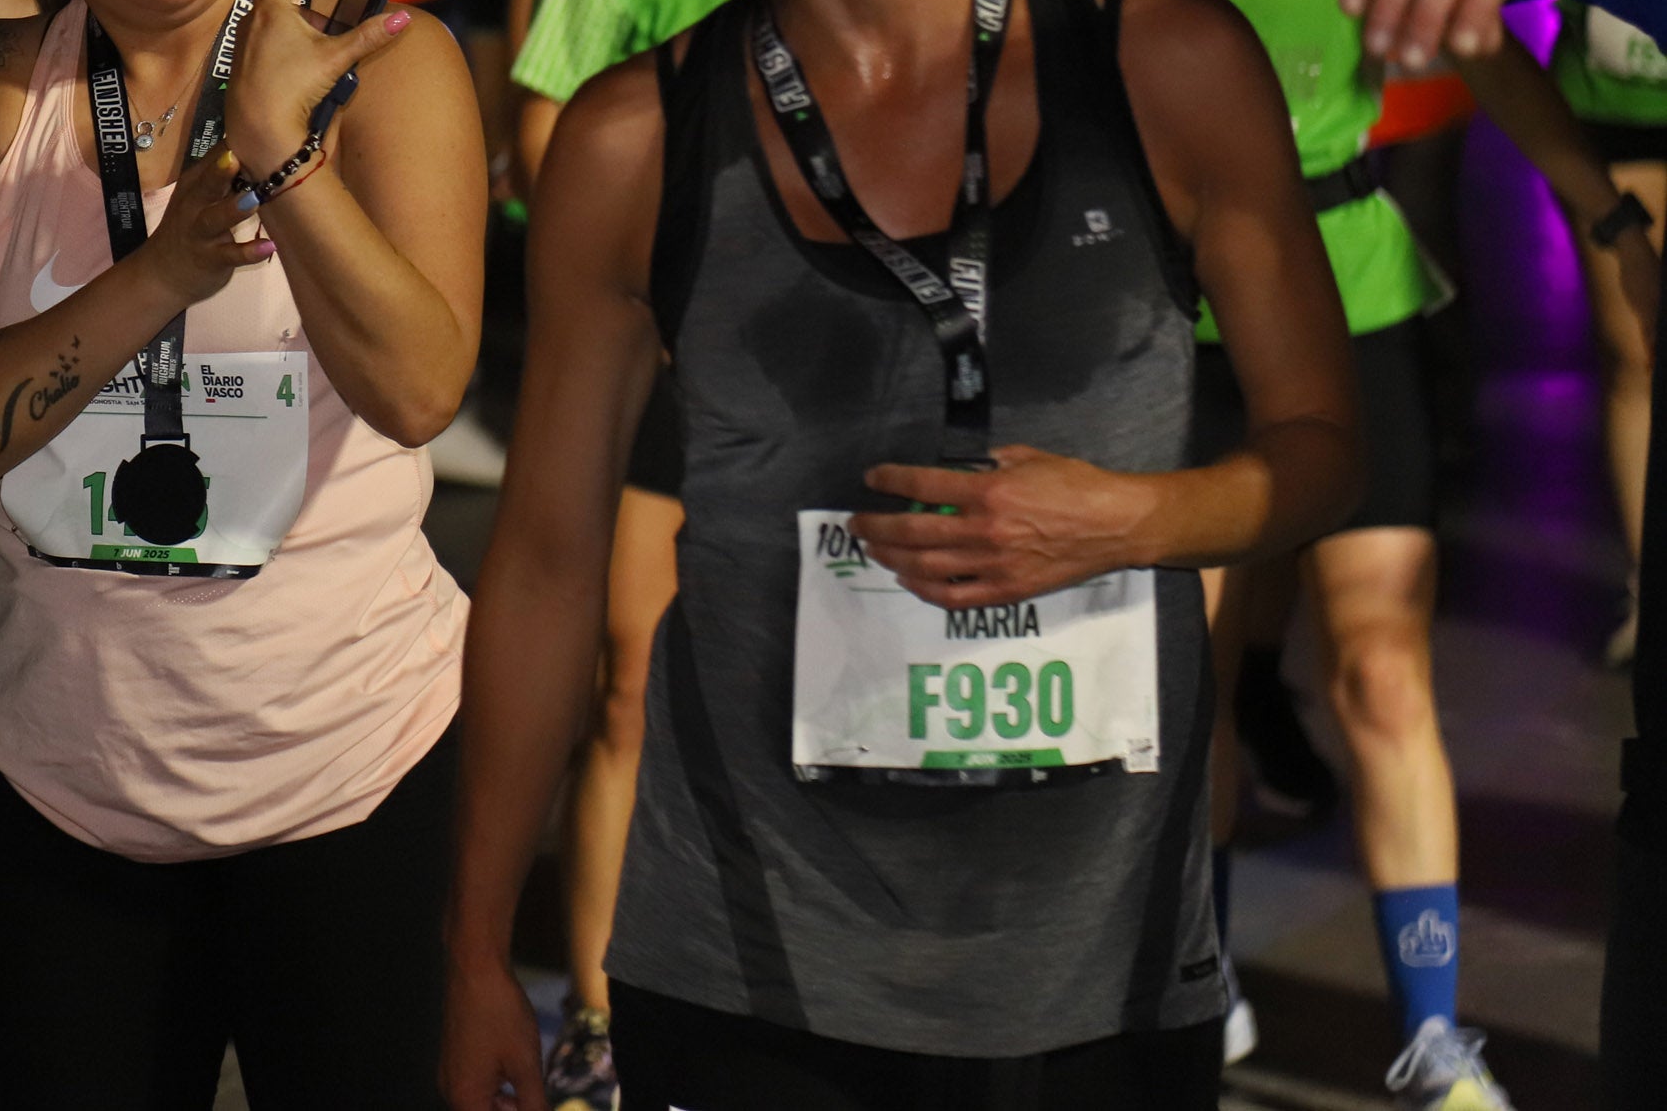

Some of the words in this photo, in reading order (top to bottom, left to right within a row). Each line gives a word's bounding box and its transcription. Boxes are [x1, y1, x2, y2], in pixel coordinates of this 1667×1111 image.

[91, 68, 129, 154] FINISHER
[197, 120, 216, 158] NIGHTRUN
[158, 341, 172, 386] NIGHTRUN
[200, 365, 215, 375] EL
[202, 376, 244, 387] DIARIO
[205, 388, 244, 398] VASCO
[276, 374, 295, 407] 4
[113, 549, 119, 557] 7
[120, 549, 141, 558] JUN
[143, 549, 170, 559] 2025
[907, 660, 1074, 740] F930
